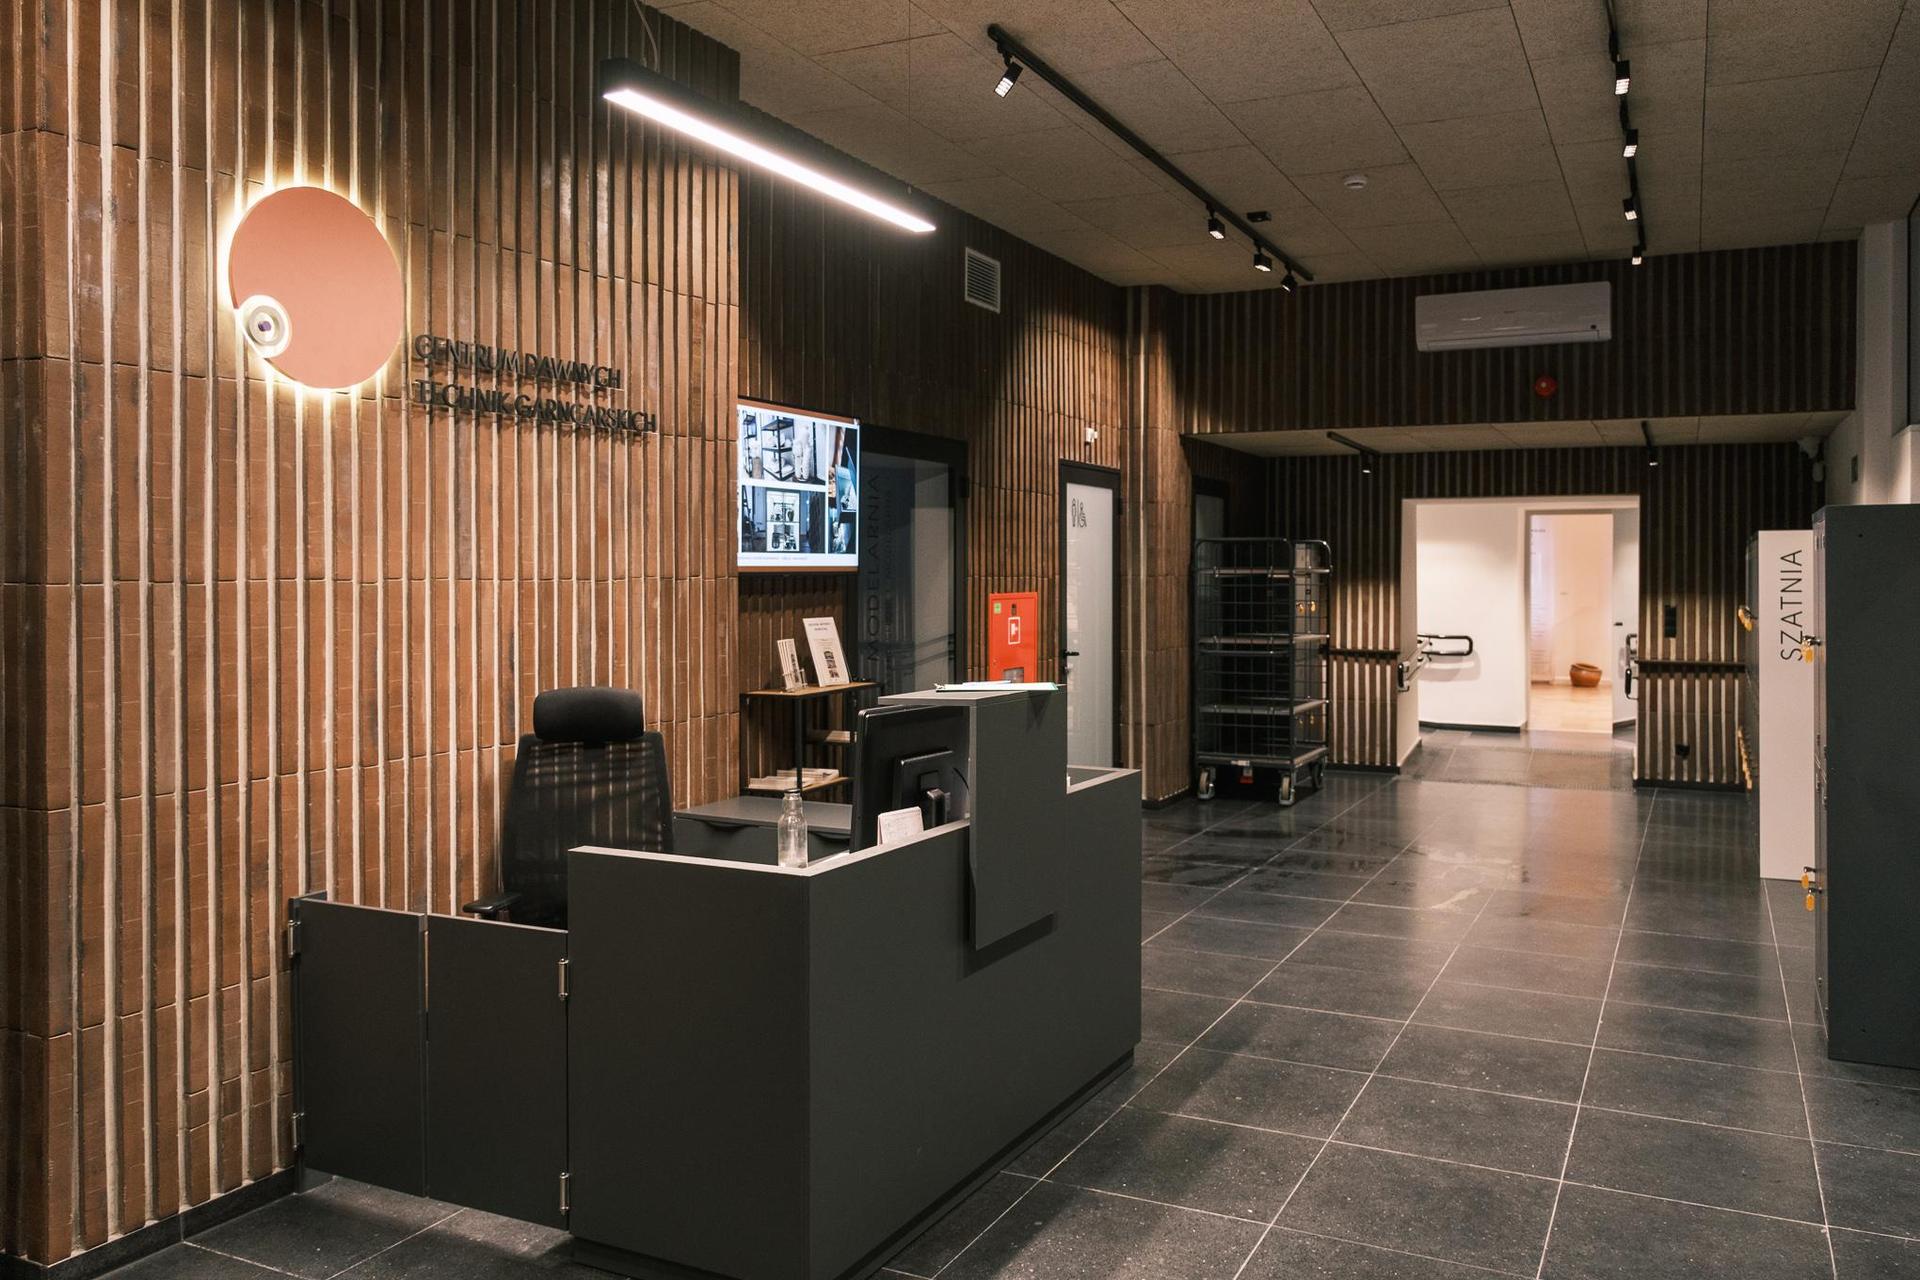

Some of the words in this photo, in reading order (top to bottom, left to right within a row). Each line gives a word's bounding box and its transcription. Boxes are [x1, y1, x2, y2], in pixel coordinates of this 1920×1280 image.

[415, 334, 520, 372] CENTRUM
[525, 353, 622, 389] DAWNYCH
[415, 378, 511, 413] TECHNIK
[514, 394, 657, 434] GARNCARSKICH
[867, 474, 880, 662] MODELARNIA
[1780, 550, 1803, 662] SZATNIA
